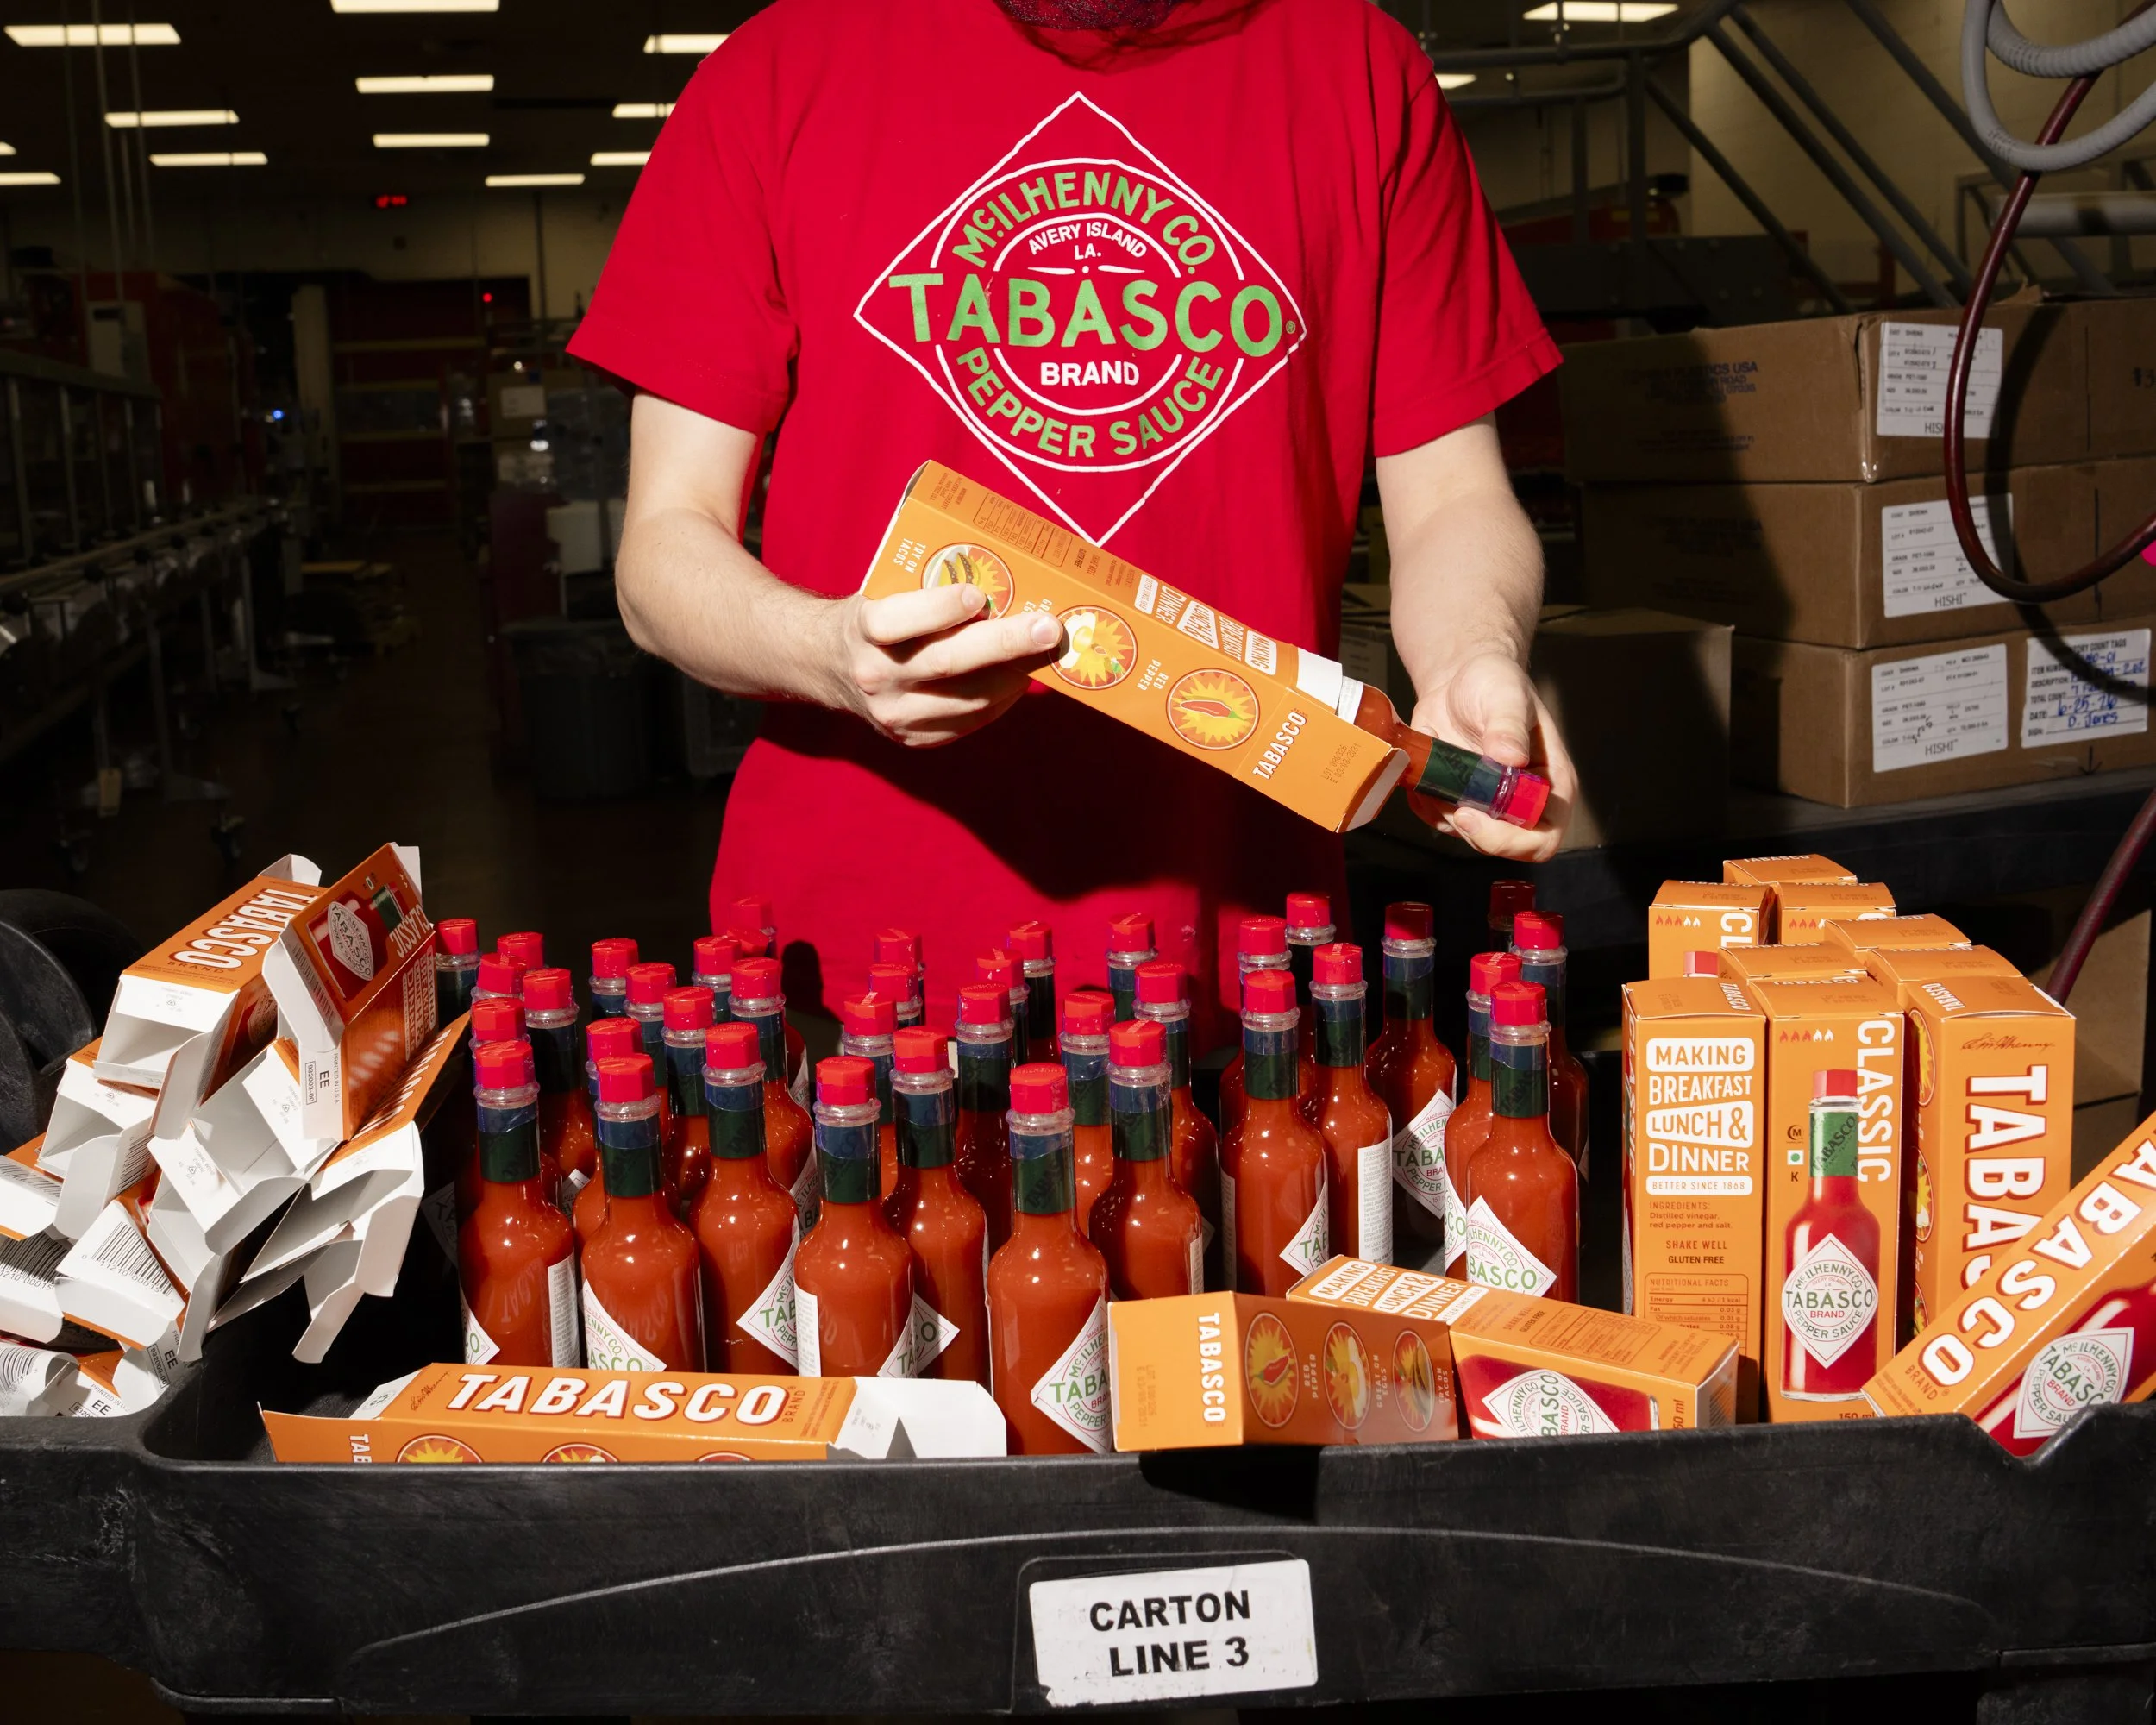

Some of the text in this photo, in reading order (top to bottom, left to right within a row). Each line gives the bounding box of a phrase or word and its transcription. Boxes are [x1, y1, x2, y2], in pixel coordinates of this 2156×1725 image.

[1029, 222, 1147, 258] AVERY ISLAND
[1074, 243, 1102, 260] LA.
[888, 273, 1283, 357] TABASCO
[1040, 360, 1140, 386] BRAND
[1733, 361, 1758, 373] USA
[956, 348, 1223, 457] PEPPER SAUCE
[1925, 423, 1945, 434] HIS
[893, 537, 914, 567] TACOS
[914, 543, 926, 561] TRY
[1156, 585, 1188, 624] DINNER
[1250, 634, 1270, 669] MAKING
[1137, 658, 1162, 692] PEPPER
[1155, 672, 1169, 690] RED
[1251, 710, 1308, 780] TABASCO
[169, 888, 319, 969] TABASCO
[388, 903, 432, 959] CLASSIC
[167, 961, 224, 975] BRAND
[1718, 983, 1752, 1011] TABASCO
[1921, 982, 1966, 1012] TABASCO
[1655, 1044, 1746, 1066] MAKING
[319, 1070, 330, 1089] EE
[1649, 1075, 1753, 1106] BREAKFAST
[1857, 1019, 1896, 1182] CLASSIC
[1651, 1107, 1748, 1141] LUNCH &
[1393, 1146, 1444, 1167] TABA
[1648, 1142, 1750, 1172] DINNER
[1408, 1168, 1442, 1192] PEPPER
[1426, 1169, 1444, 1177] BRA
[1652, 1182, 1745, 1190] BETTER SINCE 1868
[1790, 1171, 1799, 1182] K
[1961, 1064, 2049, 1294] TABA
[1665, 1240, 1727, 1250] SHAKE WELL
[1668, 1255, 1725, 1264] GLUTEN FREE
[1917, 1130, 2156, 1388] ABASCO
[99, 1260, 129, 1277] 11210
[1317, 1264, 1369, 1295] MAKING
[1469, 1255, 1538, 1289] BASCO
[1650, 1278, 1702, 1287] NUTRITIONAL
[1341, 1267, 1400, 1308] BREAKFAST
[1379, 1274, 1435, 1311] LUNCH &
[1401, 1283, 1468, 1320] DINNER
[1785, 1289, 1874, 1309] TABASCO
[1519, 1317, 1537, 1333] GLUTEN
[1532, 1310, 1547, 1323] FREE
[1794, 1309, 1864, 1339] PEPPER SAUCE
[1809, 1310, 1846, 1319] BRAND
[777, 1325, 798, 1346] PEPP
[149, 1346, 168, 1387] 932003-00
[165, 1349, 179, 1371] EE
[589, 1348, 643, 1371] ASCO
[1198, 1311, 1227, 1423] TABASCO
[1049, 1371, 1108, 1404] TABA
[1309, 1353, 1319, 1399] PEPPER
[1380, 1367, 1388, 1396] EGGS
[1441, 1369, 1451, 1403] TACOS
[1904, 1364, 1938, 1402] BRAND
[2040, 1345, 2105, 1406] TABASC
[91, 1383, 116, 1403] PRINTED
[91, 1399, 112, 1415] EE
[446, 1372, 797, 1427] TABASCO
[781, 1389, 806, 1423] BRAND
[1090, 1392, 1108, 1409] BRA
[1540, 1374, 1559, 1436] BASCO
[1560, 1389, 1590, 1421] SAUCE
[1673, 1399, 1684, 1414] ml
[2031, 1369, 2071, 1424] PEPPER SAU
[2046, 1379, 2077, 1408] BRAND
[1069, 1402, 1106, 1427] PEPPER
[1512, 1387, 1527, 1433] ILHENNY
[1088, 1590, 1251, 1633] CARTON
[1109, 1635, 1250, 1677] LINE 3
